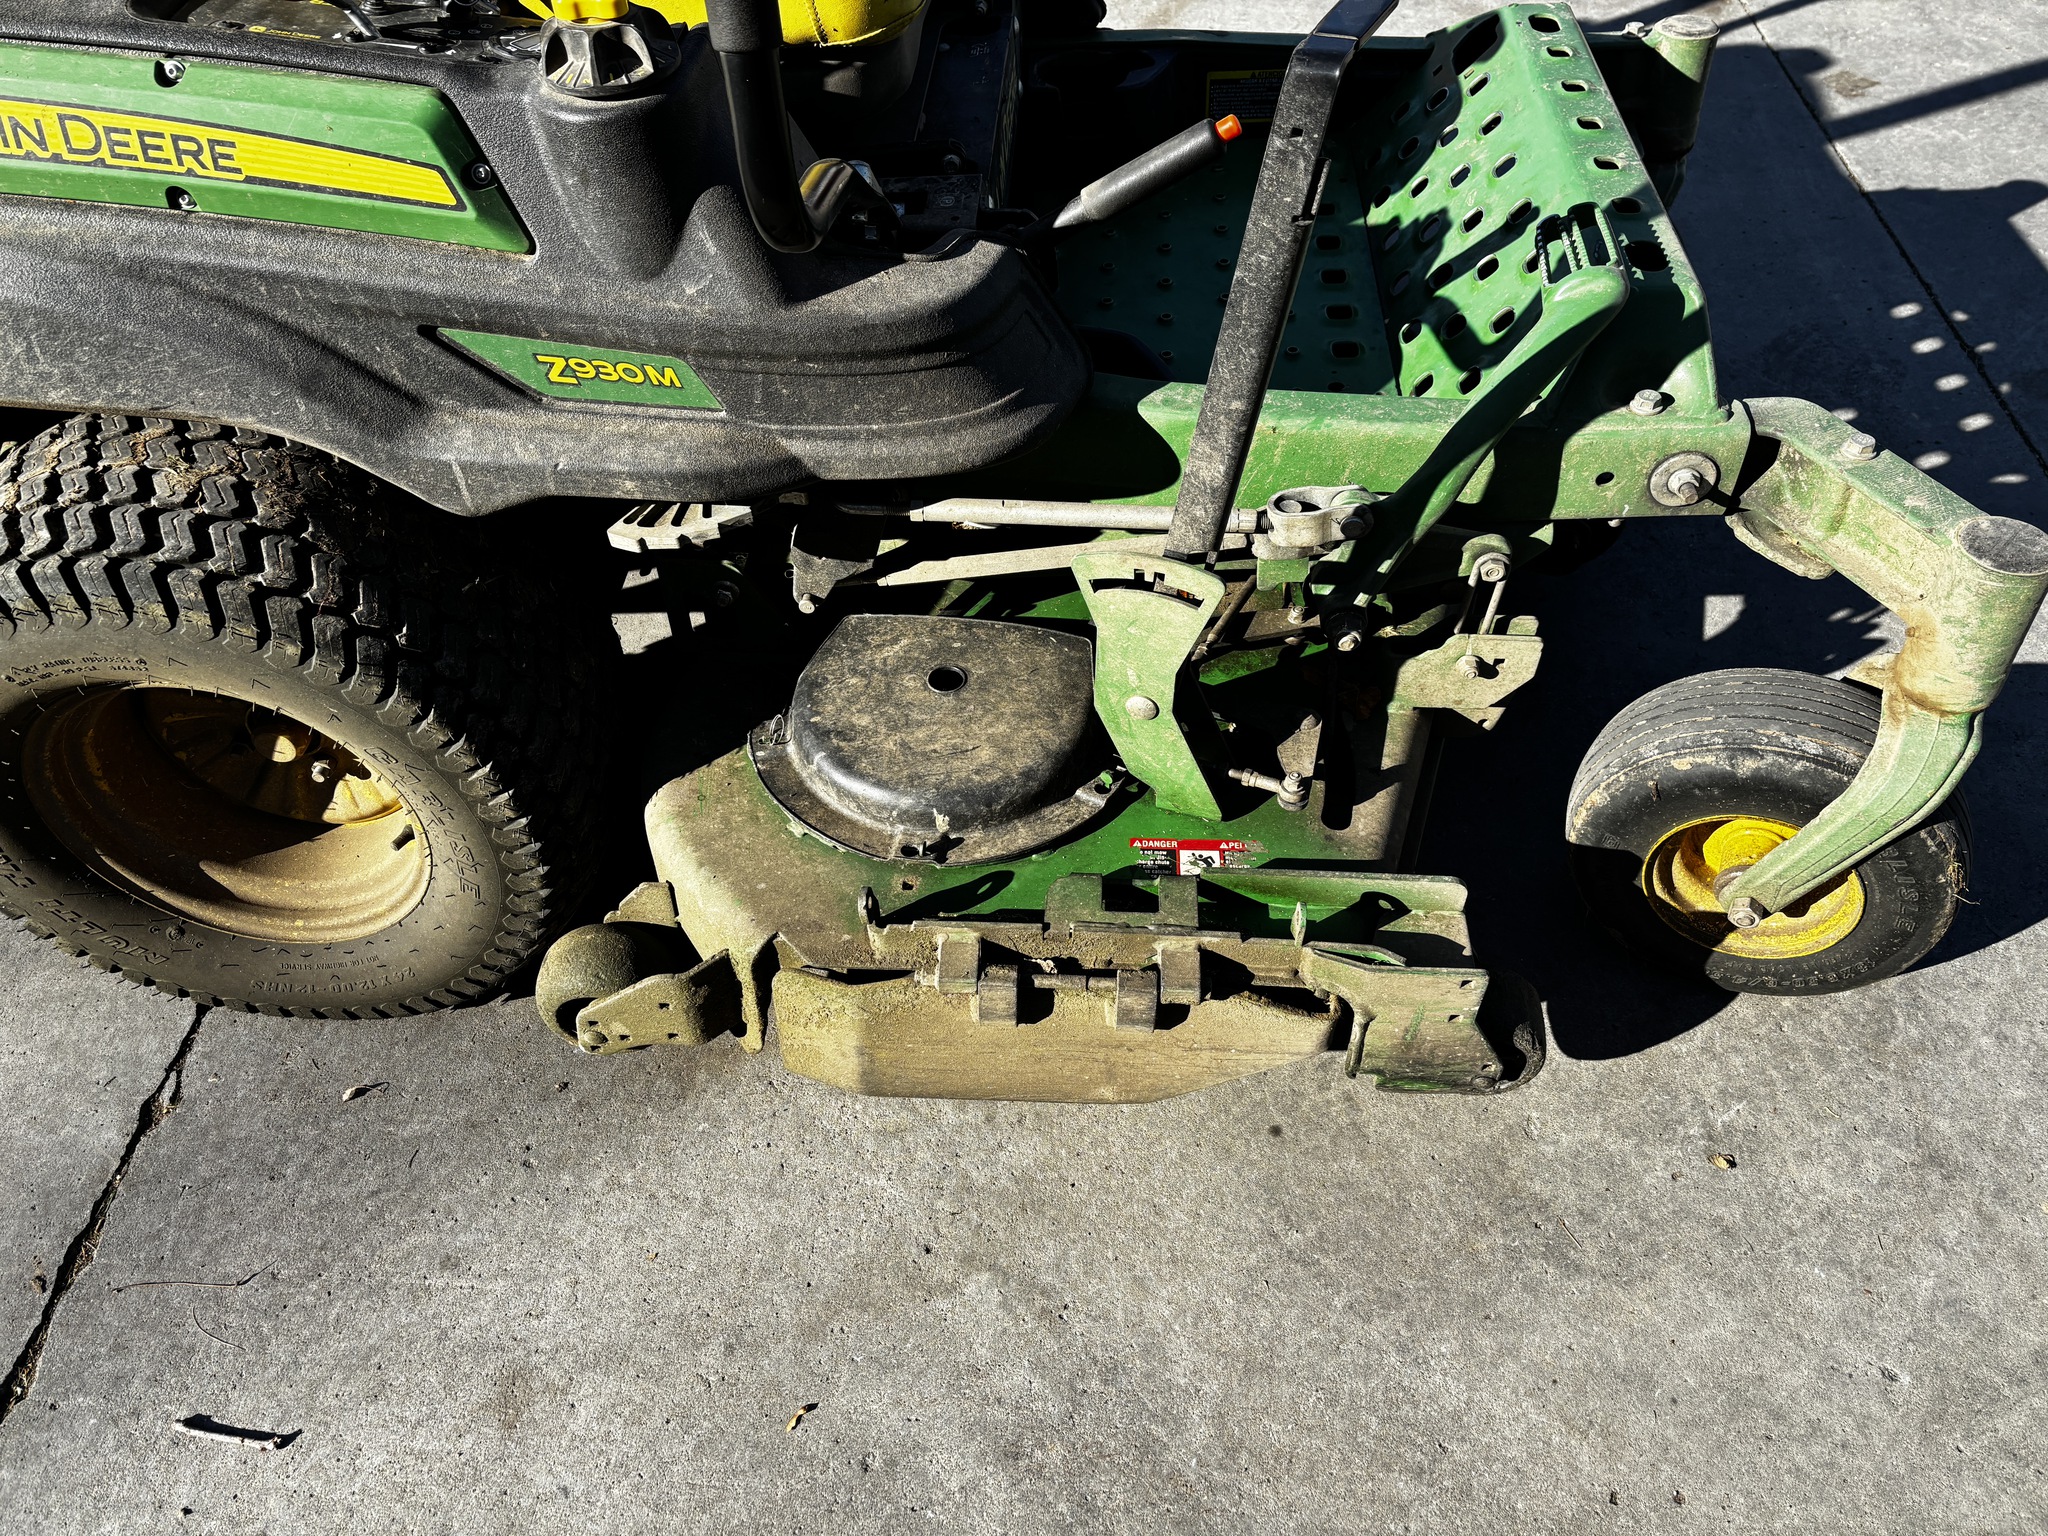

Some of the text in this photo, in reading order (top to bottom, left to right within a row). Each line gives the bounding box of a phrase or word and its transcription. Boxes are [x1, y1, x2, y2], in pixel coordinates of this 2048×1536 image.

[56, 112, 244, 175] DEERE
[533, 353, 684, 388] Z930M
[1142, 840, 1178, 848] DANGER
